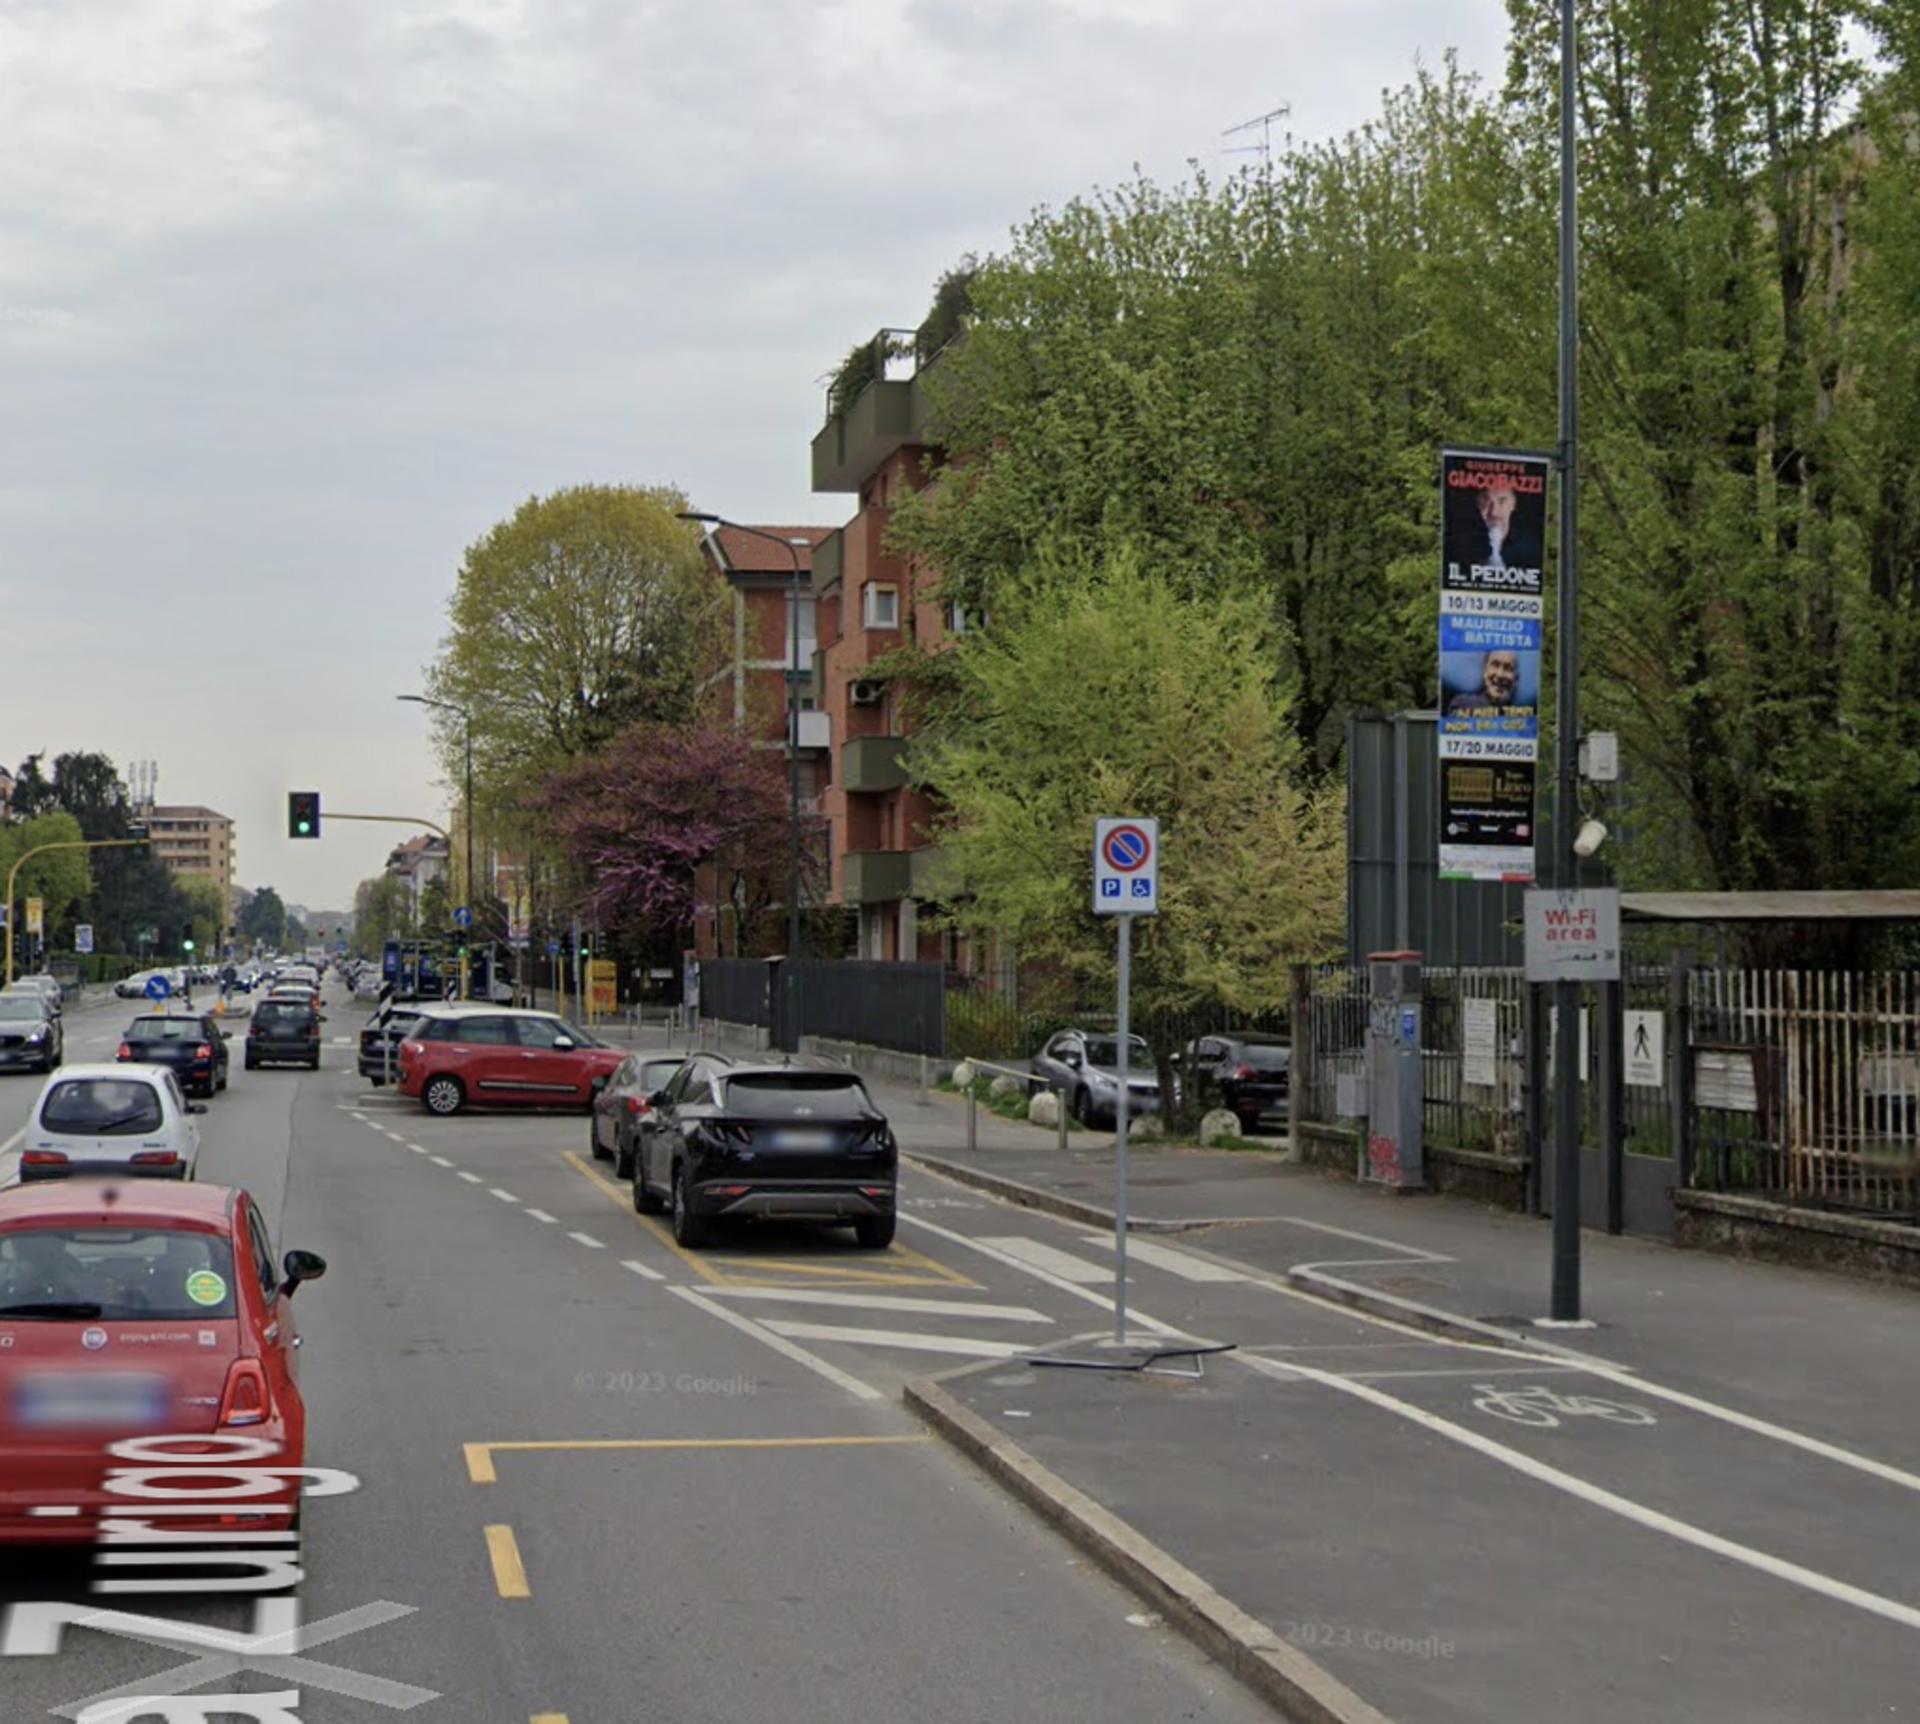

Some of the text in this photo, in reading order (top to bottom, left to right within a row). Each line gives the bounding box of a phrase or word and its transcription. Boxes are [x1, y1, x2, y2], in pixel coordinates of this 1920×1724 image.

[1448, 471, 1543, 492] GIACOBAZZI
[1449, 563, 1540, 585] IL PEDONE
[1448, 595, 1540, 613] 10/13 MAGGIO
[1451, 617, 1524, 632] MAURIZIO
[1464, 631, 1532, 647] BATTISTA
[1446, 740, 1534, 757] 17/20 MAGGIO
[1105, 880, 1117, 895] P
[1545, 908, 1597, 925] Wi-Fi
[1546, 928, 1597, 941] area
